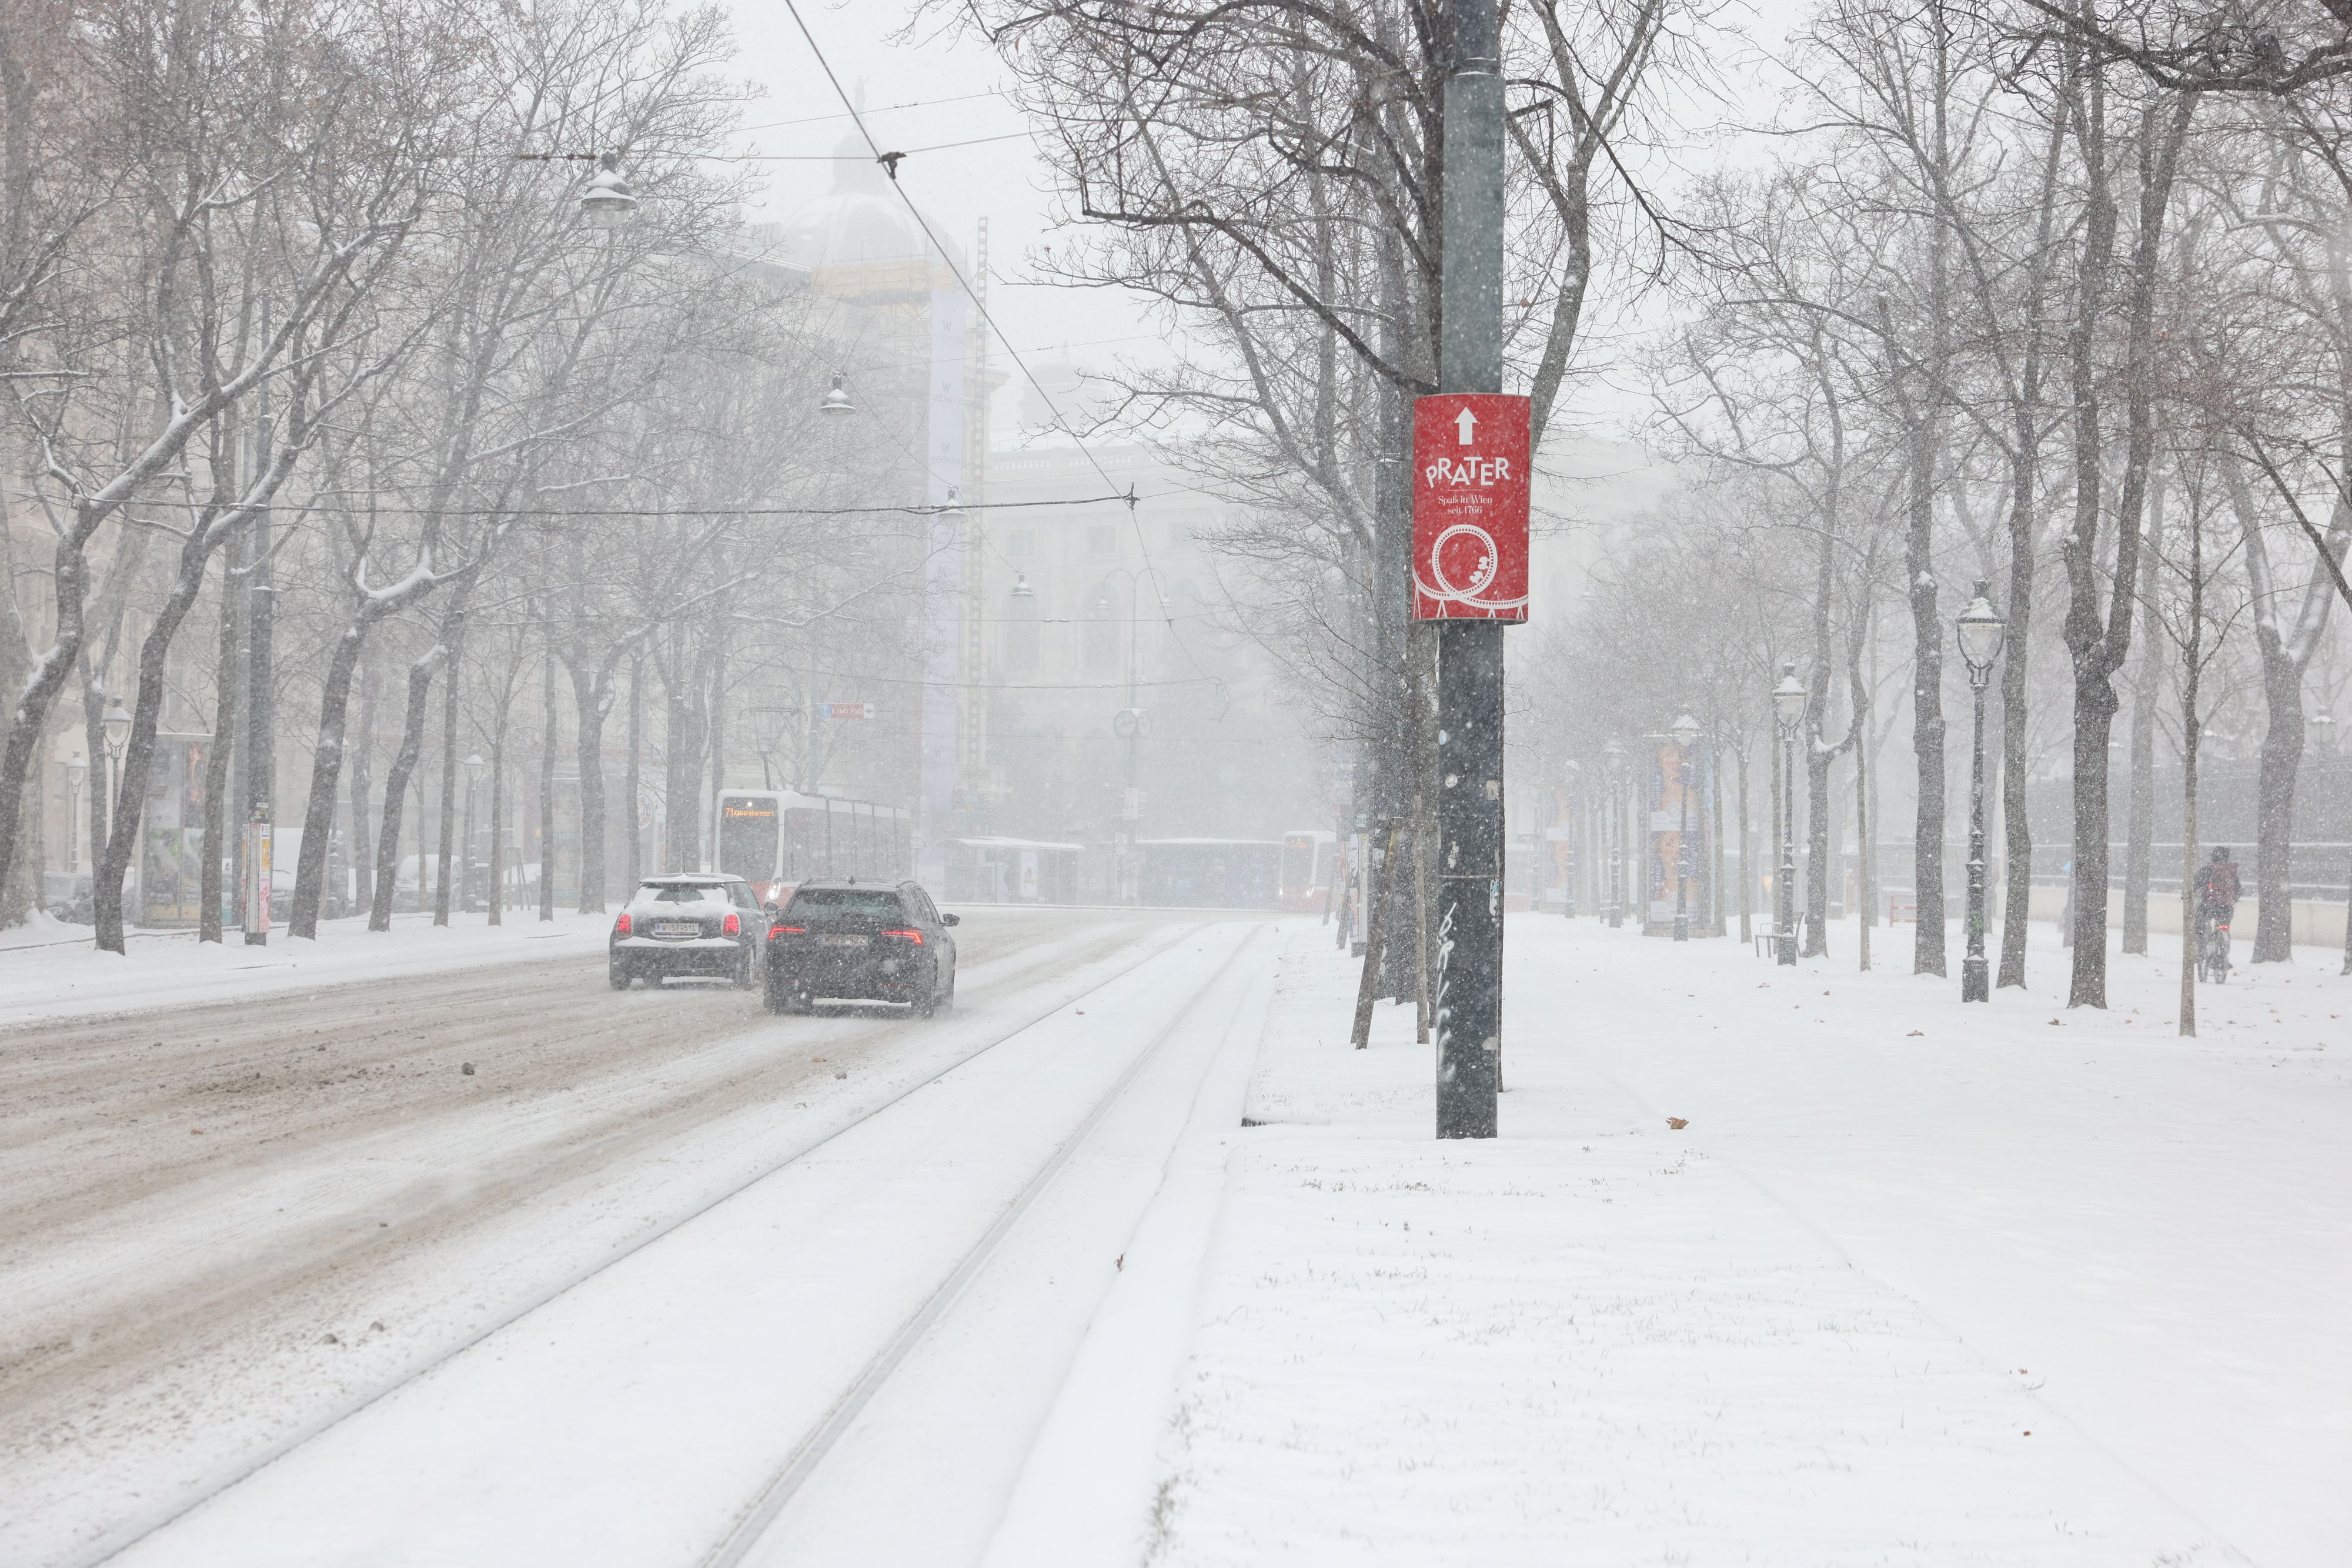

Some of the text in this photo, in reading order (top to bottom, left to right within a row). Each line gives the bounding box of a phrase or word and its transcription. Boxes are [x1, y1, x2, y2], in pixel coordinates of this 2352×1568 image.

[1426, 456, 1511, 489] PRATER
[1438, 494, 1492, 506] Spaß in Wien
[1447, 506, 1482, 514] seit 1766
[726, 807, 734, 817] 71
